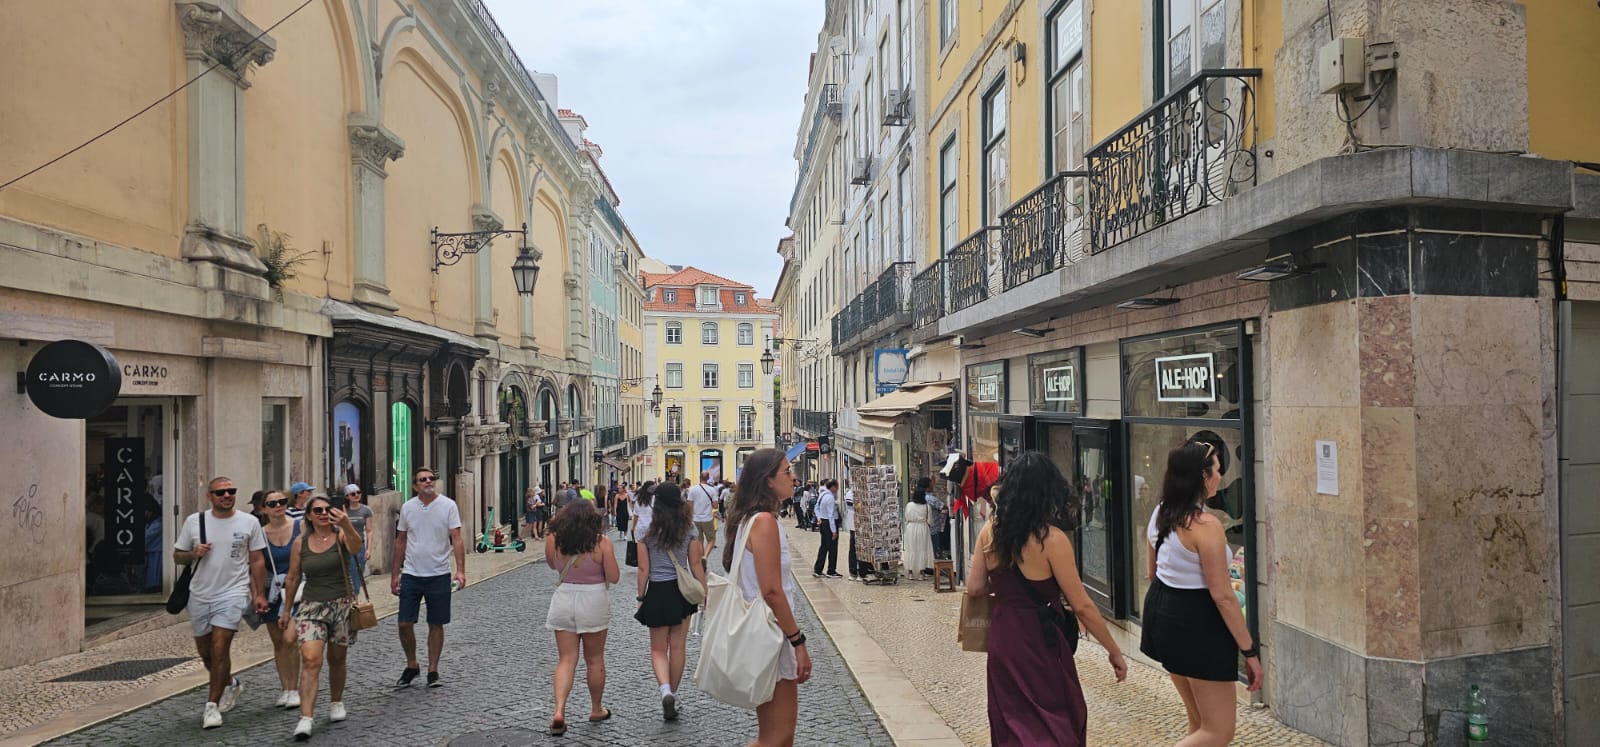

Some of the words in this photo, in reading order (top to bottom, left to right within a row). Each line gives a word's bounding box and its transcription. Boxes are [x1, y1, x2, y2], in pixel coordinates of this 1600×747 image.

[38, 372, 96, 382] CARMO
[124, 365, 168, 379] CARMO
[1162, 366, 1209, 390] ALE-HOP
[980, 382, 996, 396] ALE-HOP
[1047, 375, 1071, 393] ALE-HOP
[116, 447, 134, 545] CARMO
